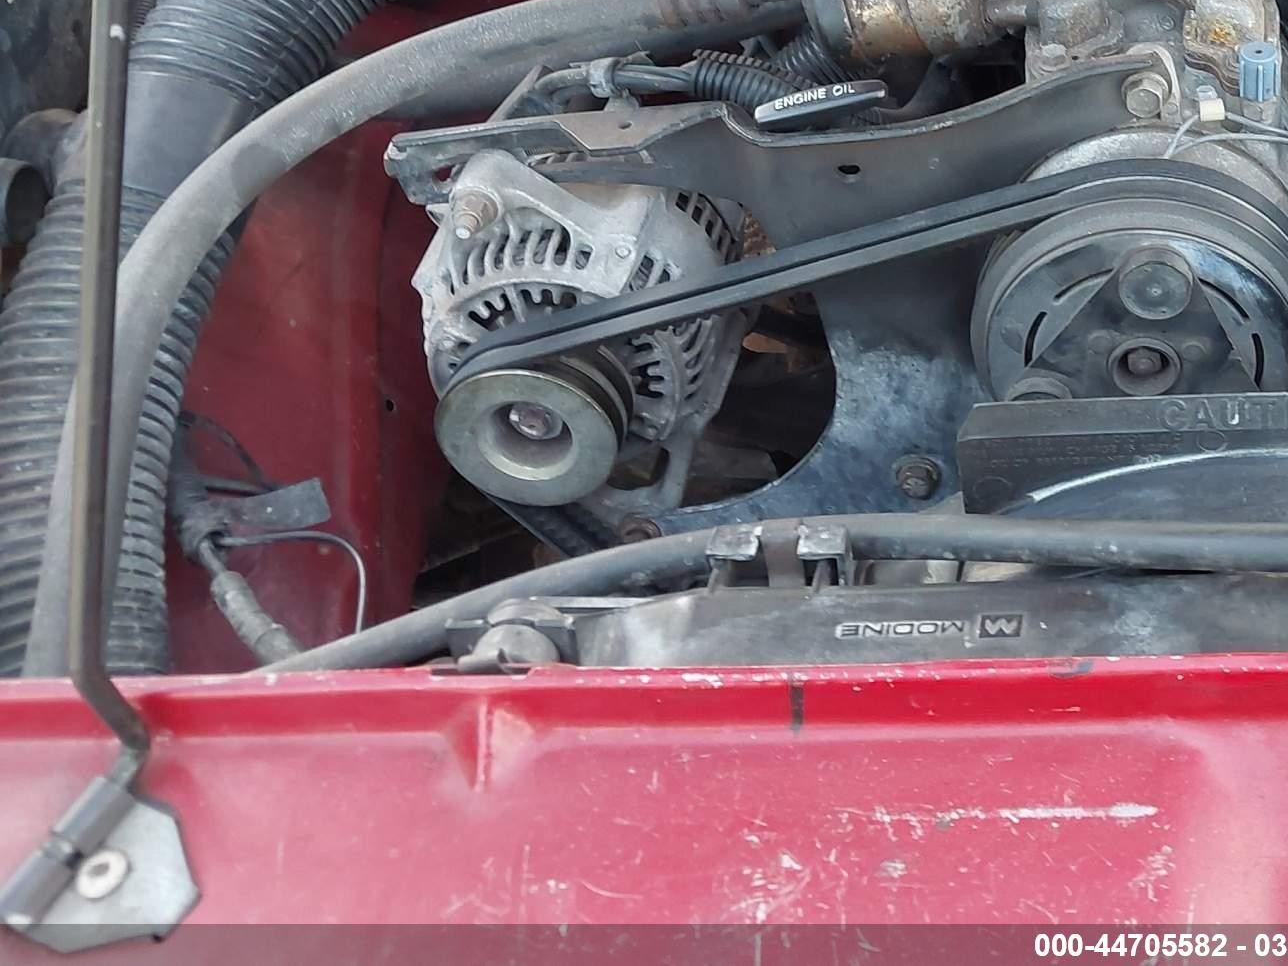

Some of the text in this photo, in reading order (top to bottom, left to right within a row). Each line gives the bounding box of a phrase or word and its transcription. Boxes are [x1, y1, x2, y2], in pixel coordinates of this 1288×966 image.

[775, 84, 856, 110] ENGINE OIL
[838, 620, 966, 639] MODINE
